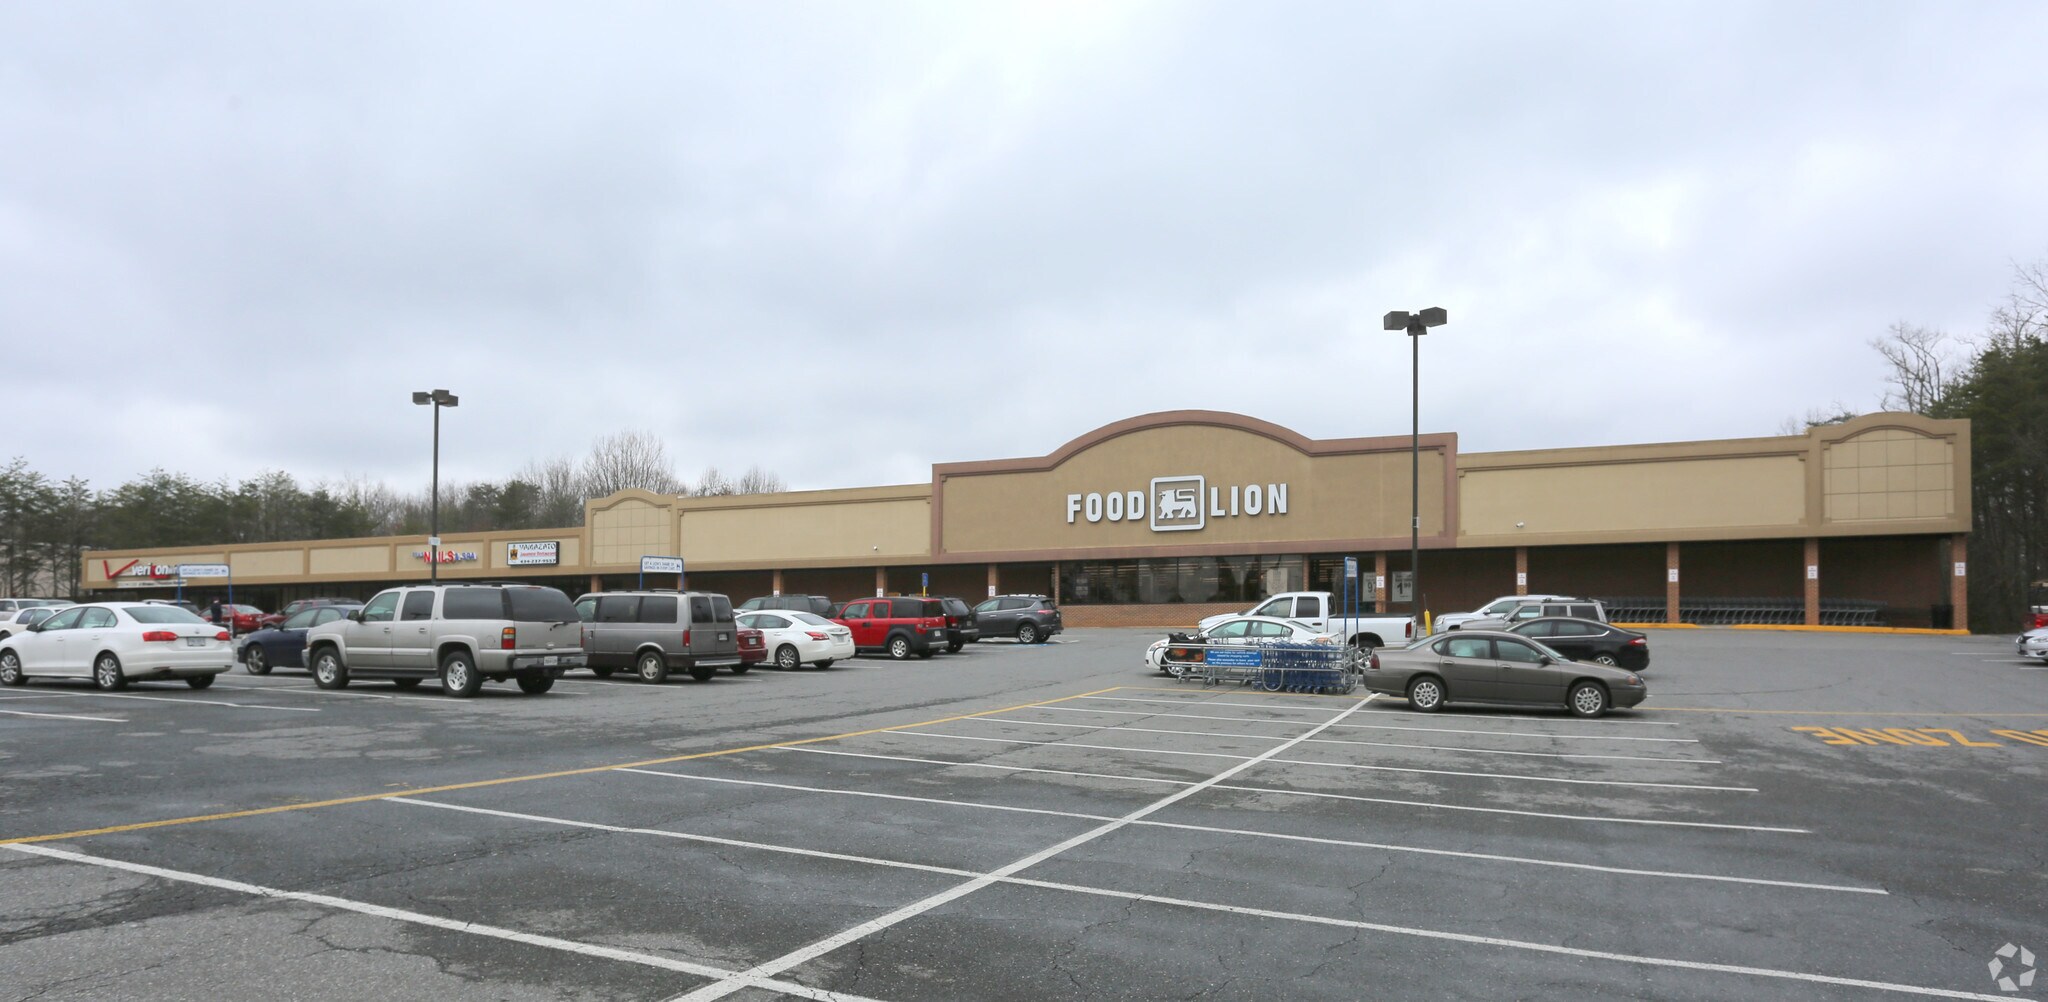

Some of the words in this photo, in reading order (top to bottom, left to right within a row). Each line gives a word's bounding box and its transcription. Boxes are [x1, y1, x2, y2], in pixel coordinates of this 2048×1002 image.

[1067, 491, 1145, 523] FOOD
[1210, 483, 1287, 516] LION
[423, 550, 454, 563] NILS
[131, 563, 170, 578] verizon
[1791, 727, 2003, 747] ZONE
